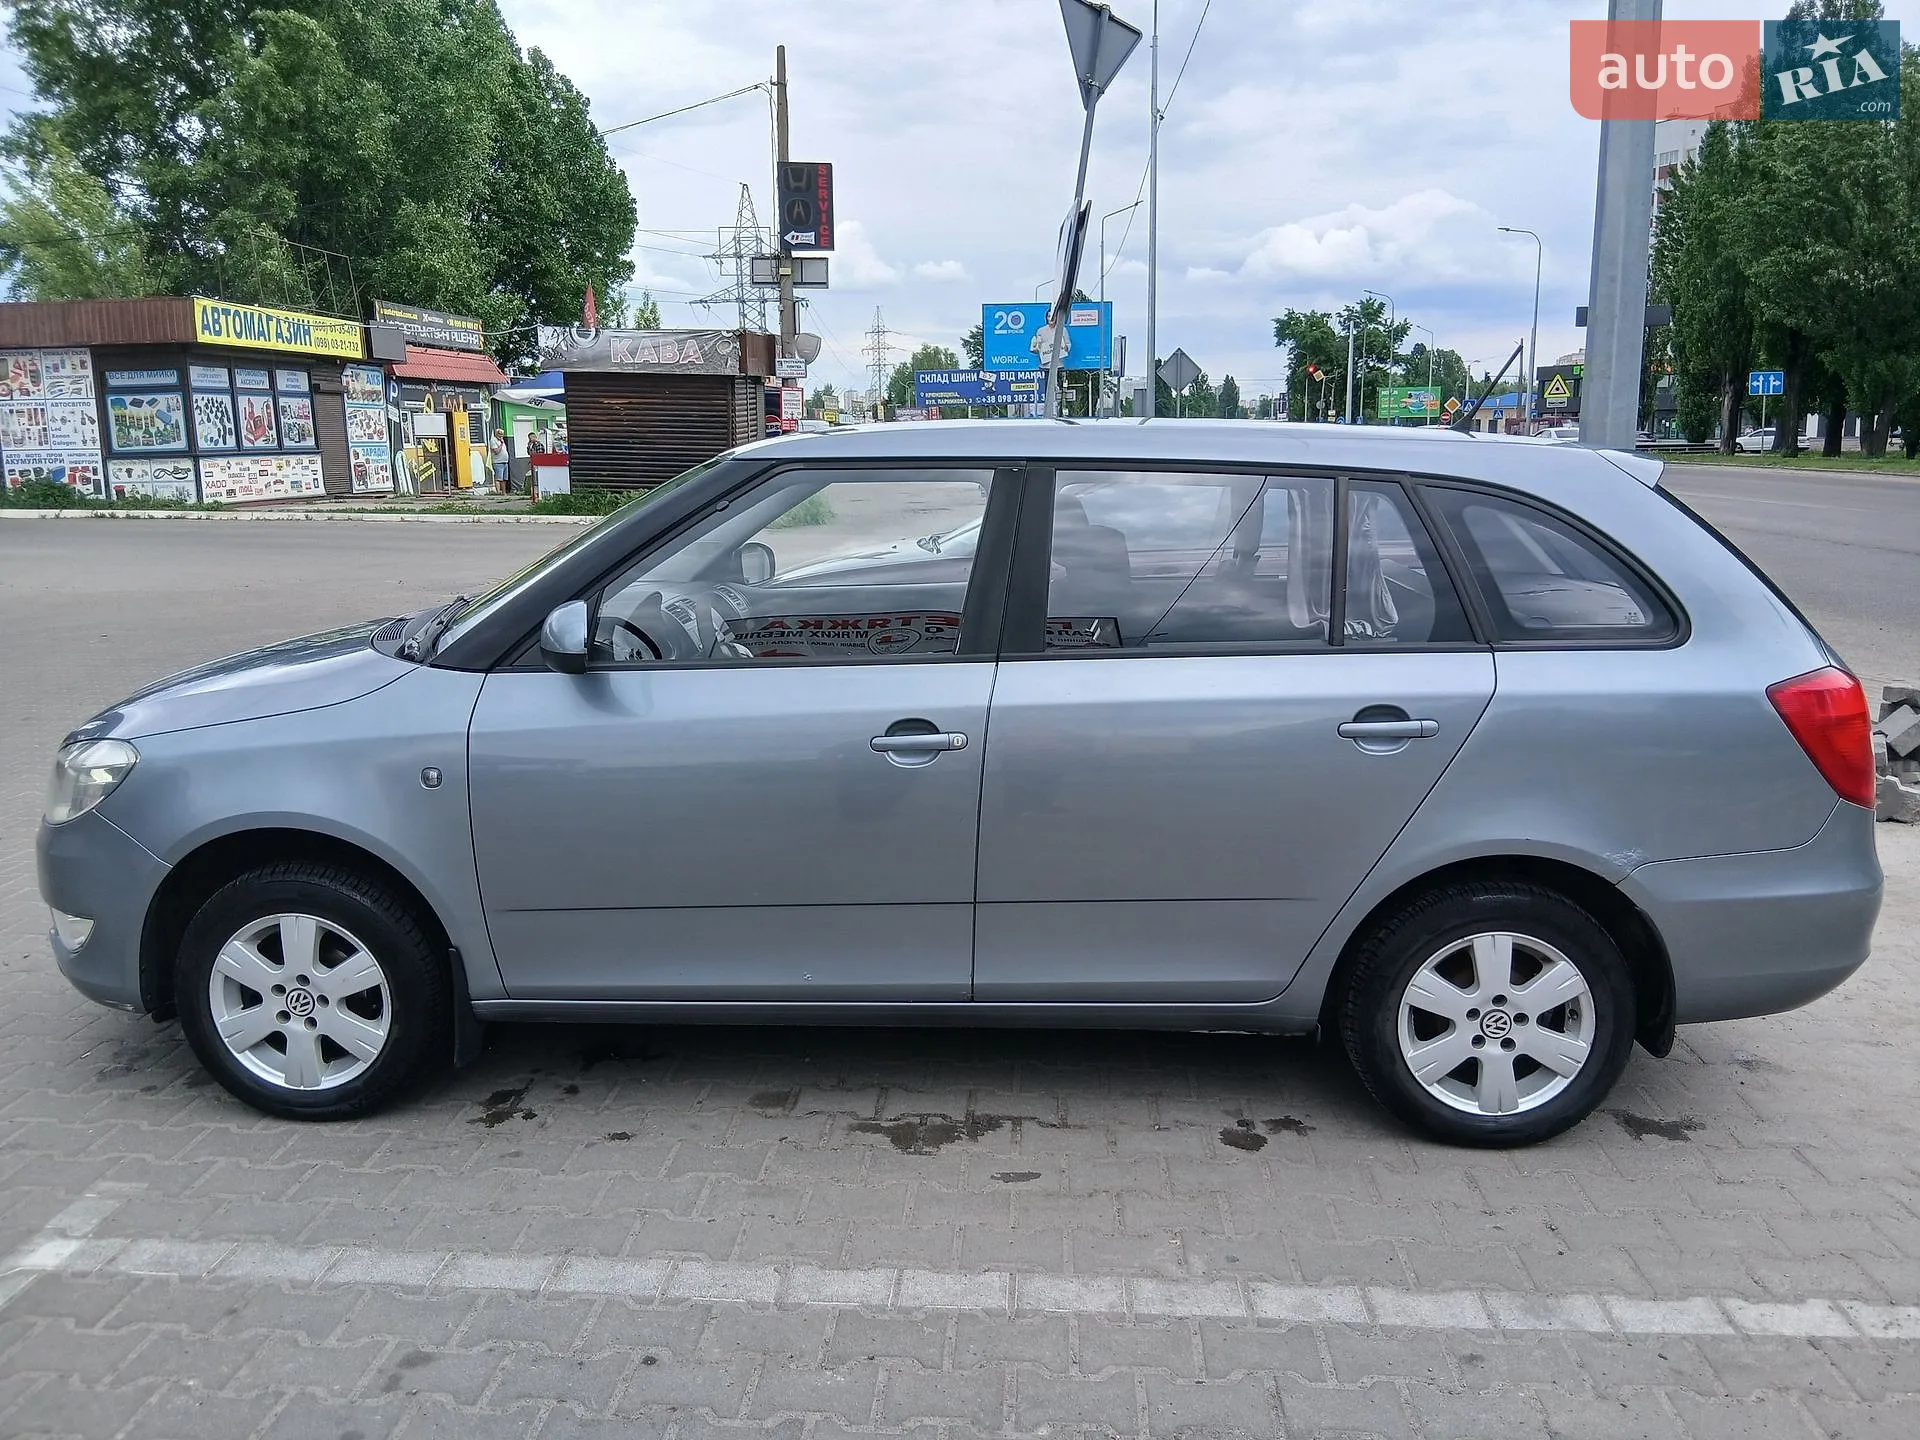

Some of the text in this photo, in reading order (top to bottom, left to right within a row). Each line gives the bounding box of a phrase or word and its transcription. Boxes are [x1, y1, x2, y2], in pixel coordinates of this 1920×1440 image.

[817, 164, 829, 247] SERVICE
[201, 304, 312, 347] АВТОМАГАЗИН
[994, 310, 1025, 330] 20
[610, 338, 704, 364] КАВА
[991, 355, 1029, 364] WORK.ua
[109, 372, 126, 380] ВСЕ
[127, 371, 145, 380] ДЛЯ
[919, 374, 949, 384] СКЛАД
[951, 372, 978, 382] ШИНИ
[1000, 371, 1016, 381] ВІД
[981, 395, 996, 404] +38
[204, 479, 227, 489] XADO
